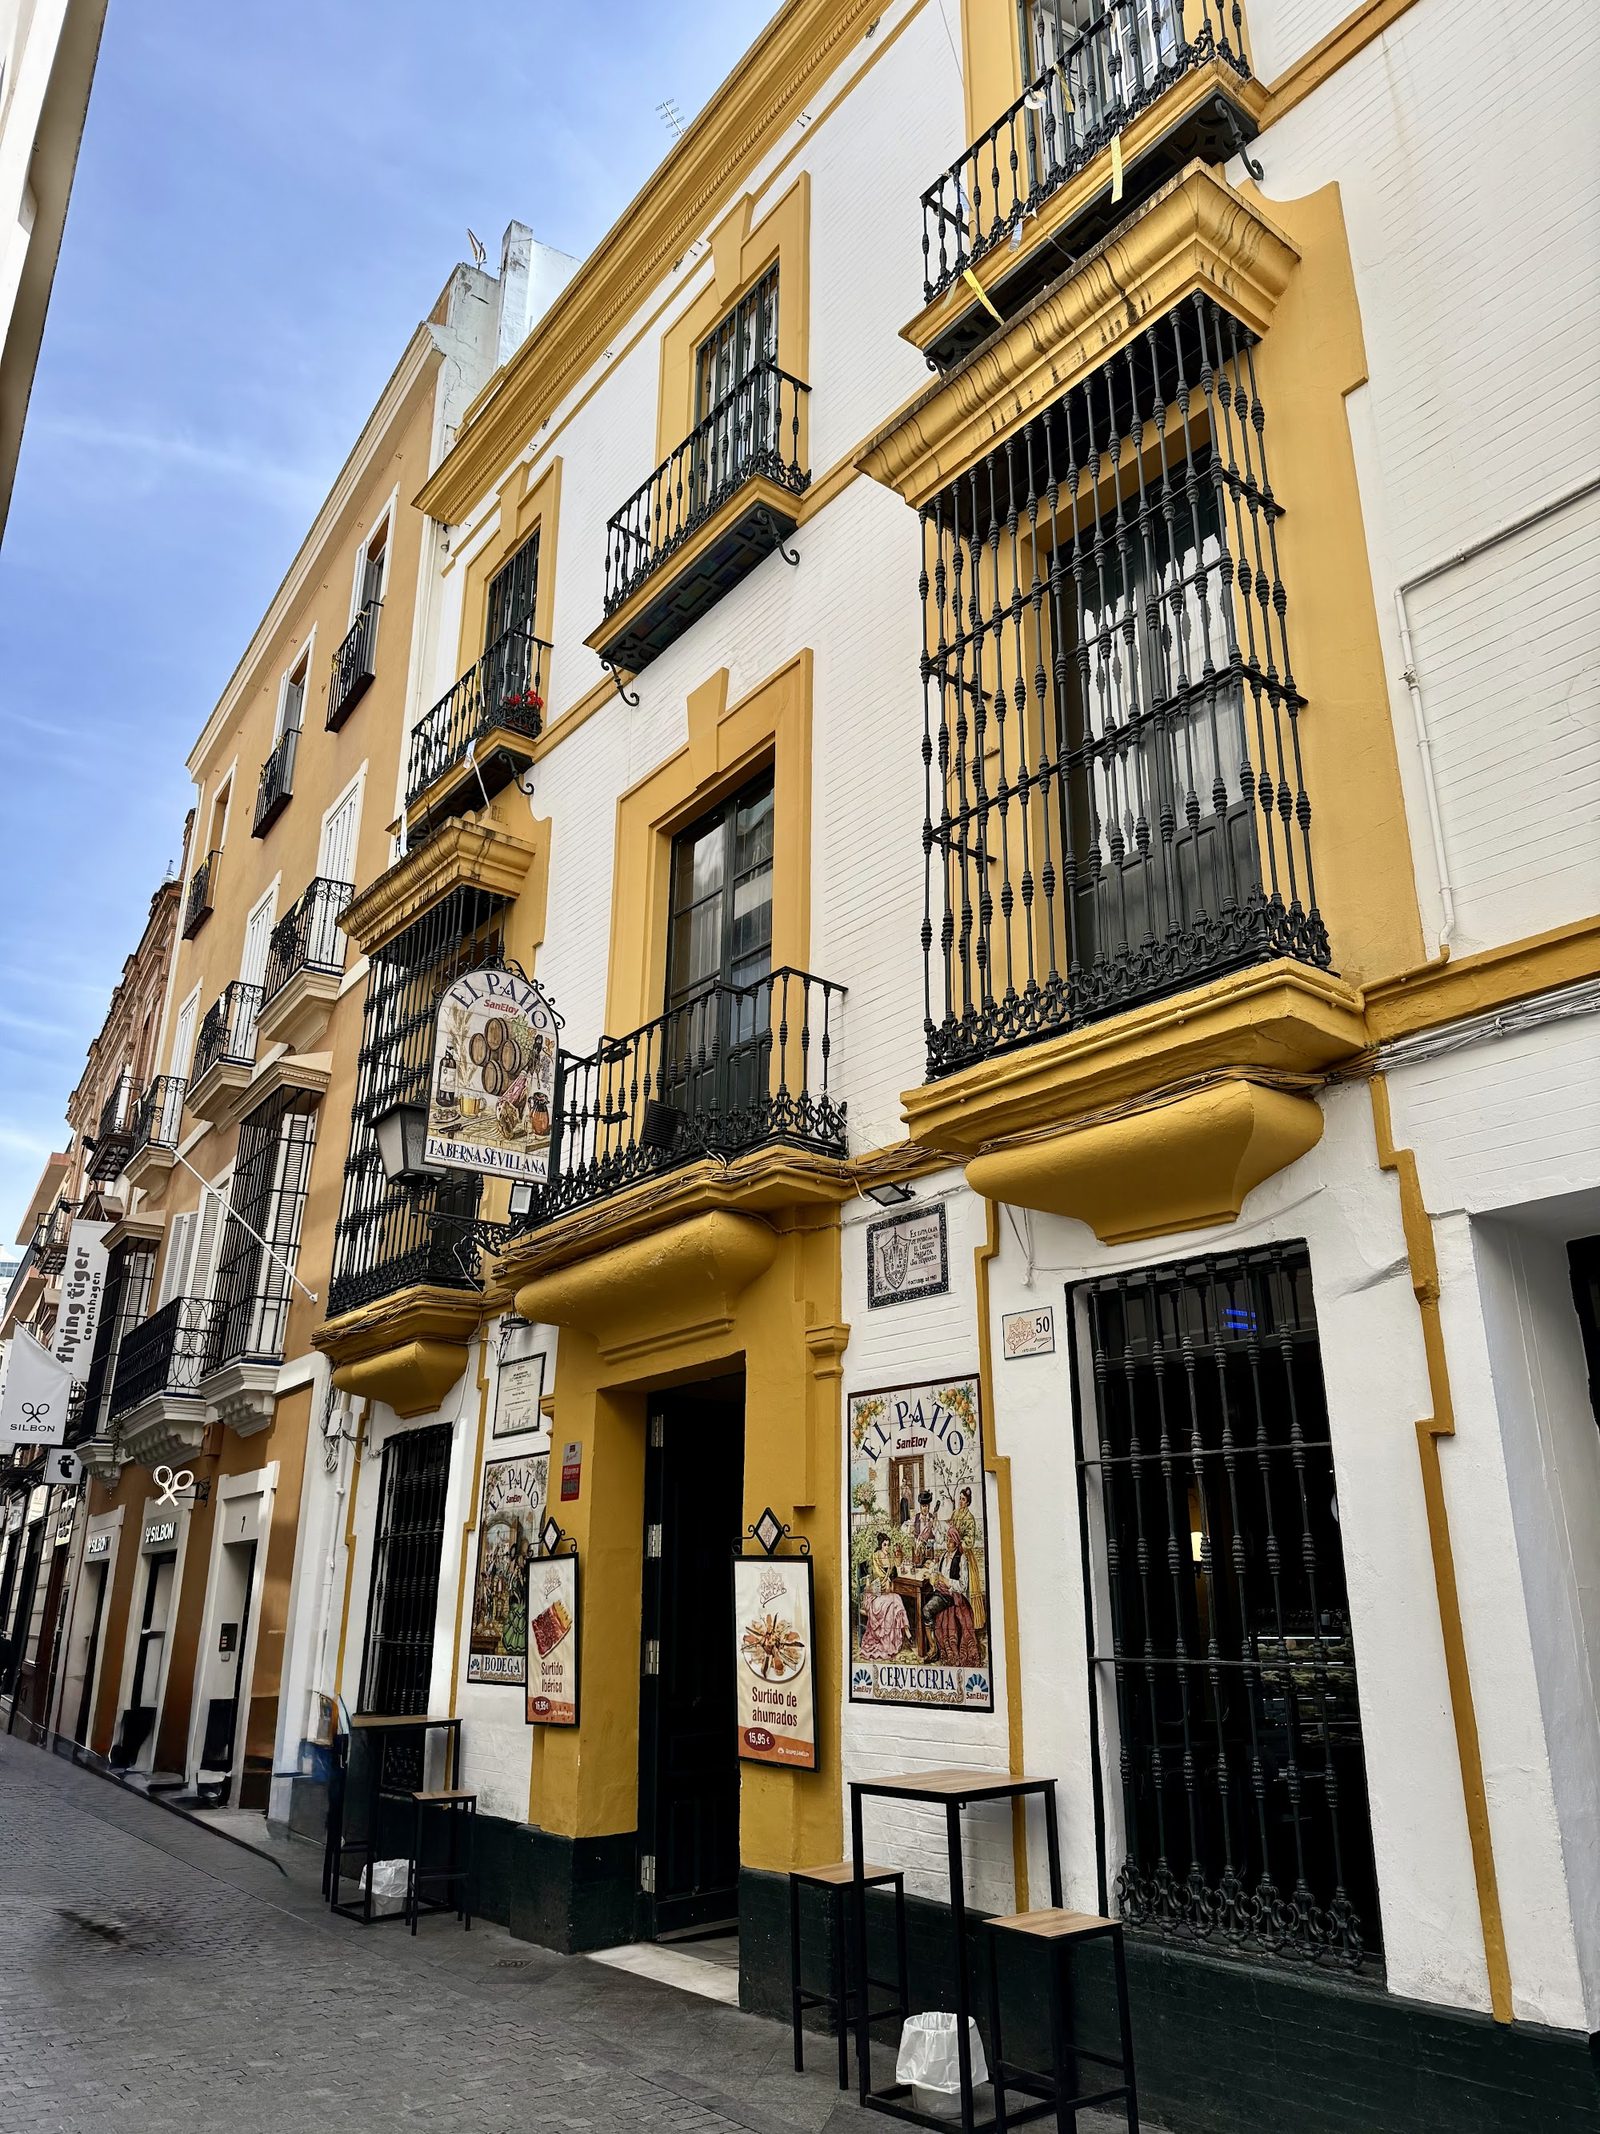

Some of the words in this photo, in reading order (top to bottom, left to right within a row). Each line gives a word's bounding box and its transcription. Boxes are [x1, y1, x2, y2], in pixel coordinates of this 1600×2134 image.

[449, 979, 484, 1009] EL
[485, 973, 547, 1029] PATIO
[483, 999, 519, 1015] SanEloy
[428, 1139, 482, 1163] TABERNA
[483, 1147, 546, 1175] SEVILLANA
[67, 1246, 91, 1299] tiger
[84, 1272, 101, 1340] copenhagen
[56, 1303, 86, 1363] flying
[1035, 1315, 1050, 1334] 50
[10, 1423, 55, 1433] SILBON
[861, 1421, 892, 1463] EL
[895, 1399, 964, 1456] PATIO
[896, 1437, 928, 1450] SanEloy
[489, 1484, 505, 1512] EL
[508, 1468, 539, 1509] PATIO
[150, 1522, 176, 1543] SILBON
[484, 1656, 521, 1673] BODEGA
[541, 1661, 564, 1676] Surtido
[541, 1678, 563, 1693] Ibérico
[880, 1666, 956, 1690] CERVECERIA
[752, 1686, 784, 1705] Surtido
[786, 1691, 797, 1707] de
[853, 1685, 872, 1694] SanEloy
[966, 1692, 989, 1701] SanEloy
[752, 1706, 798, 1727] ahumados
[748, 1731, 766, 1745] 15,95
